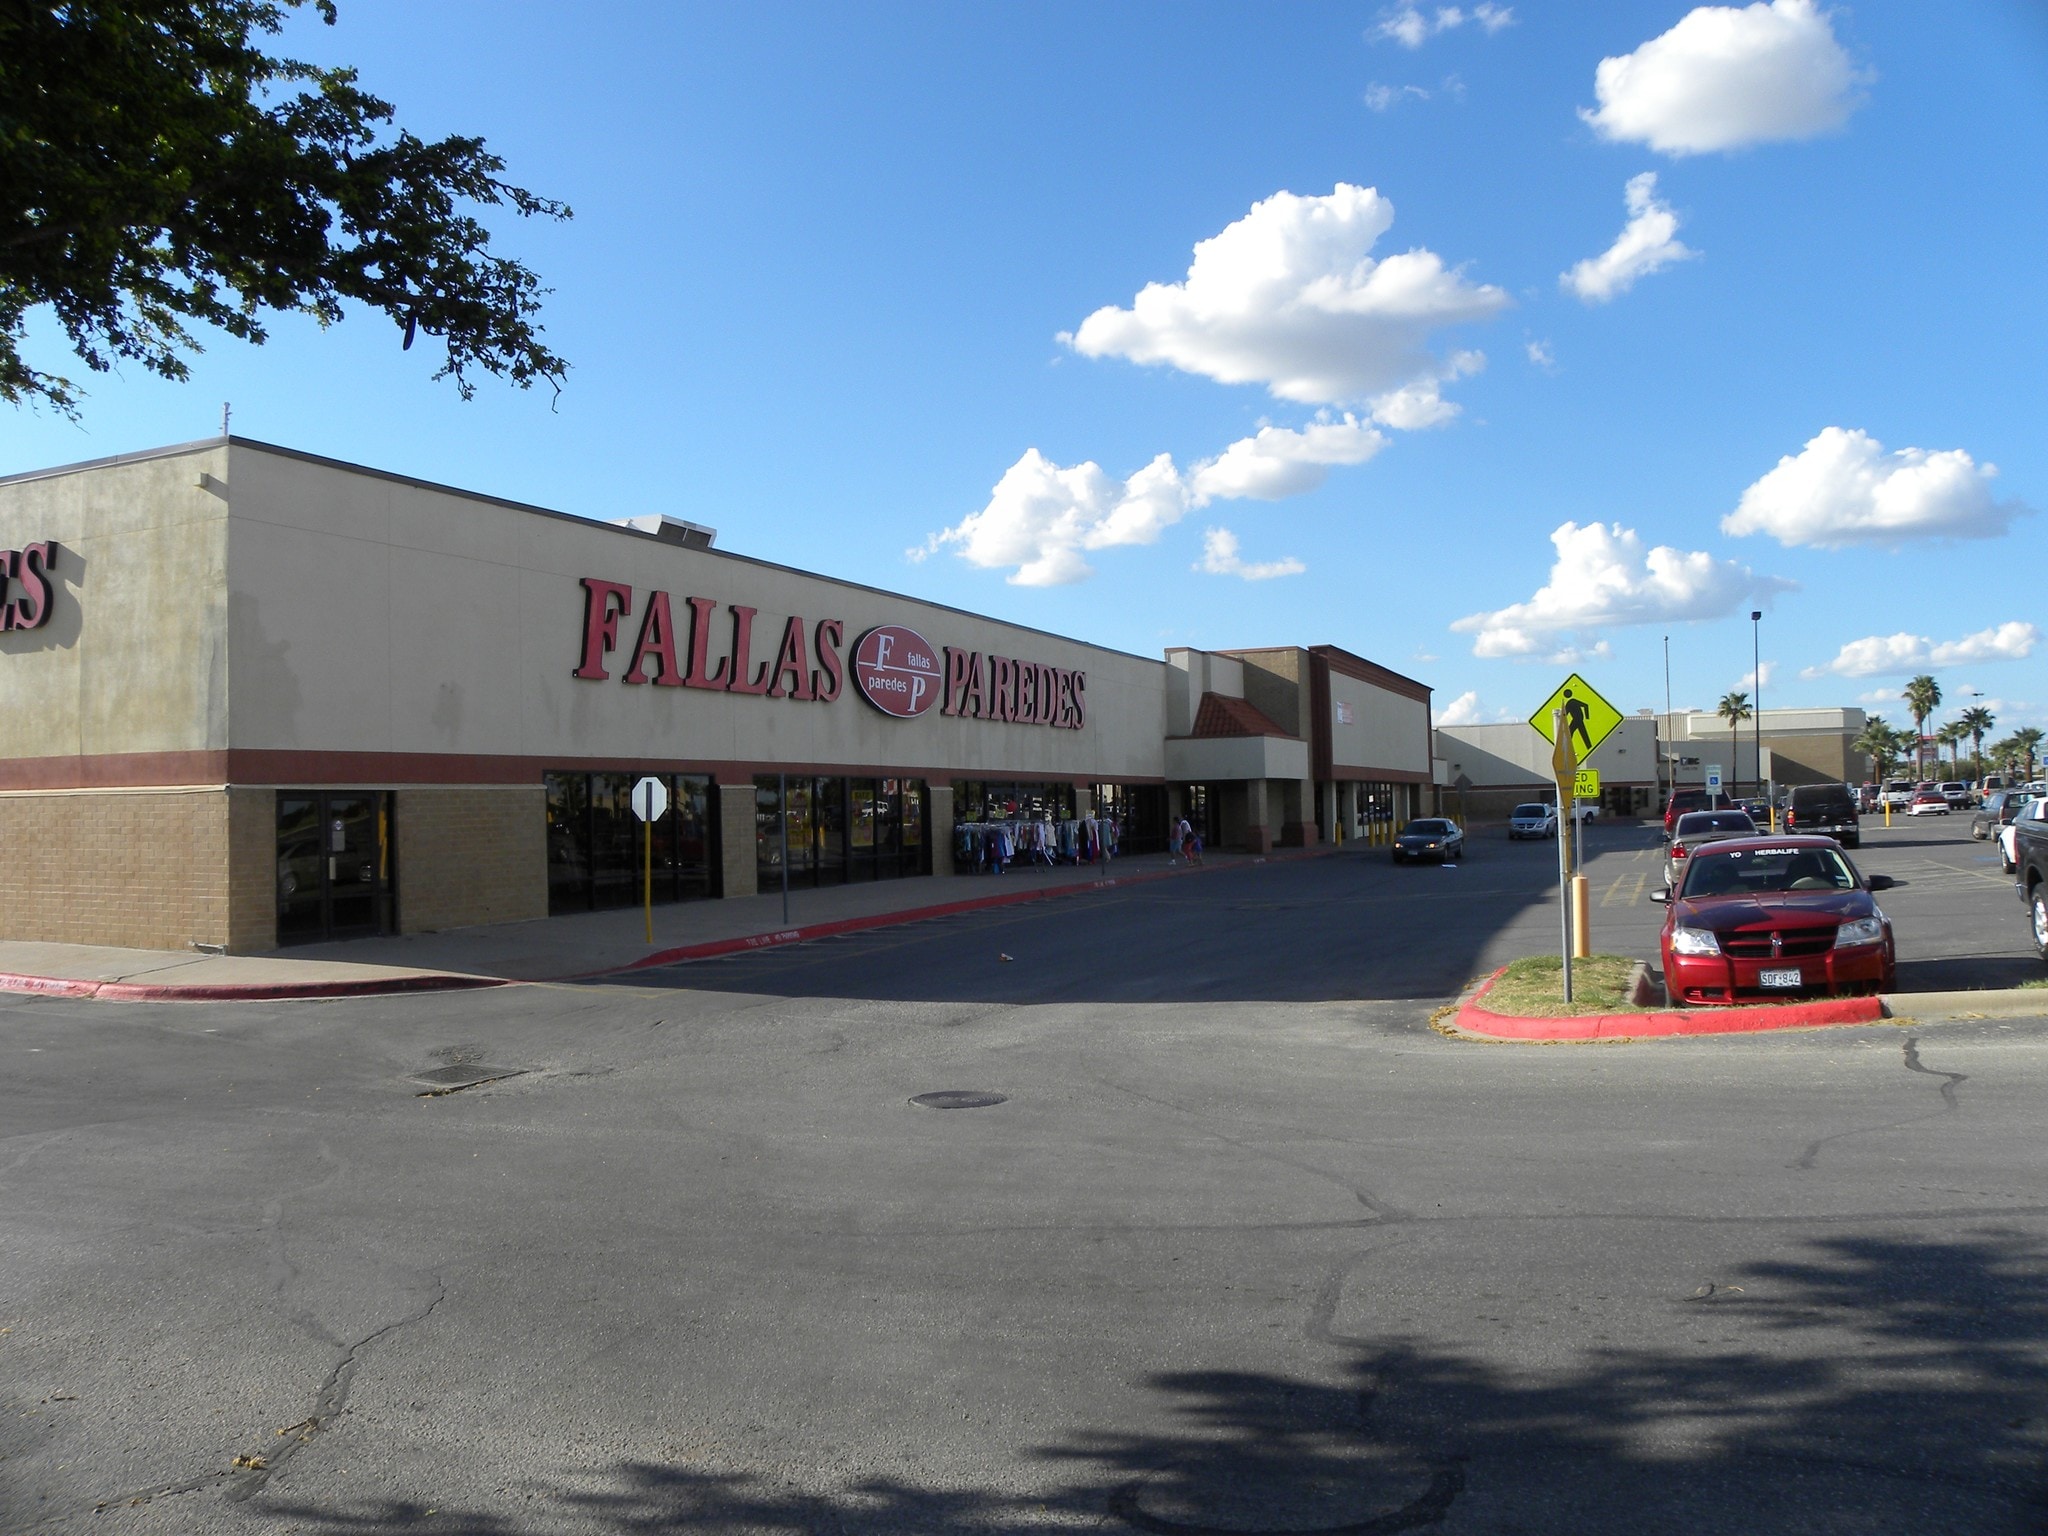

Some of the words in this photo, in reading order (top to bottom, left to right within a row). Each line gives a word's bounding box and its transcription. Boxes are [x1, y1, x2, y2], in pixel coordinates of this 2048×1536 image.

[572, 577, 843, 702] FALLAS
[907, 652, 931, 669] fallas
[868, 676, 907, 692] paredes
[940, 646, 1086, 729] PAREDES
[1574, 773, 1588, 782] ED
[1575, 784, 1594, 793] ING
[1729, 851, 1742, 859] YO
[1754, 847, 1799, 856] HERBALIFE
